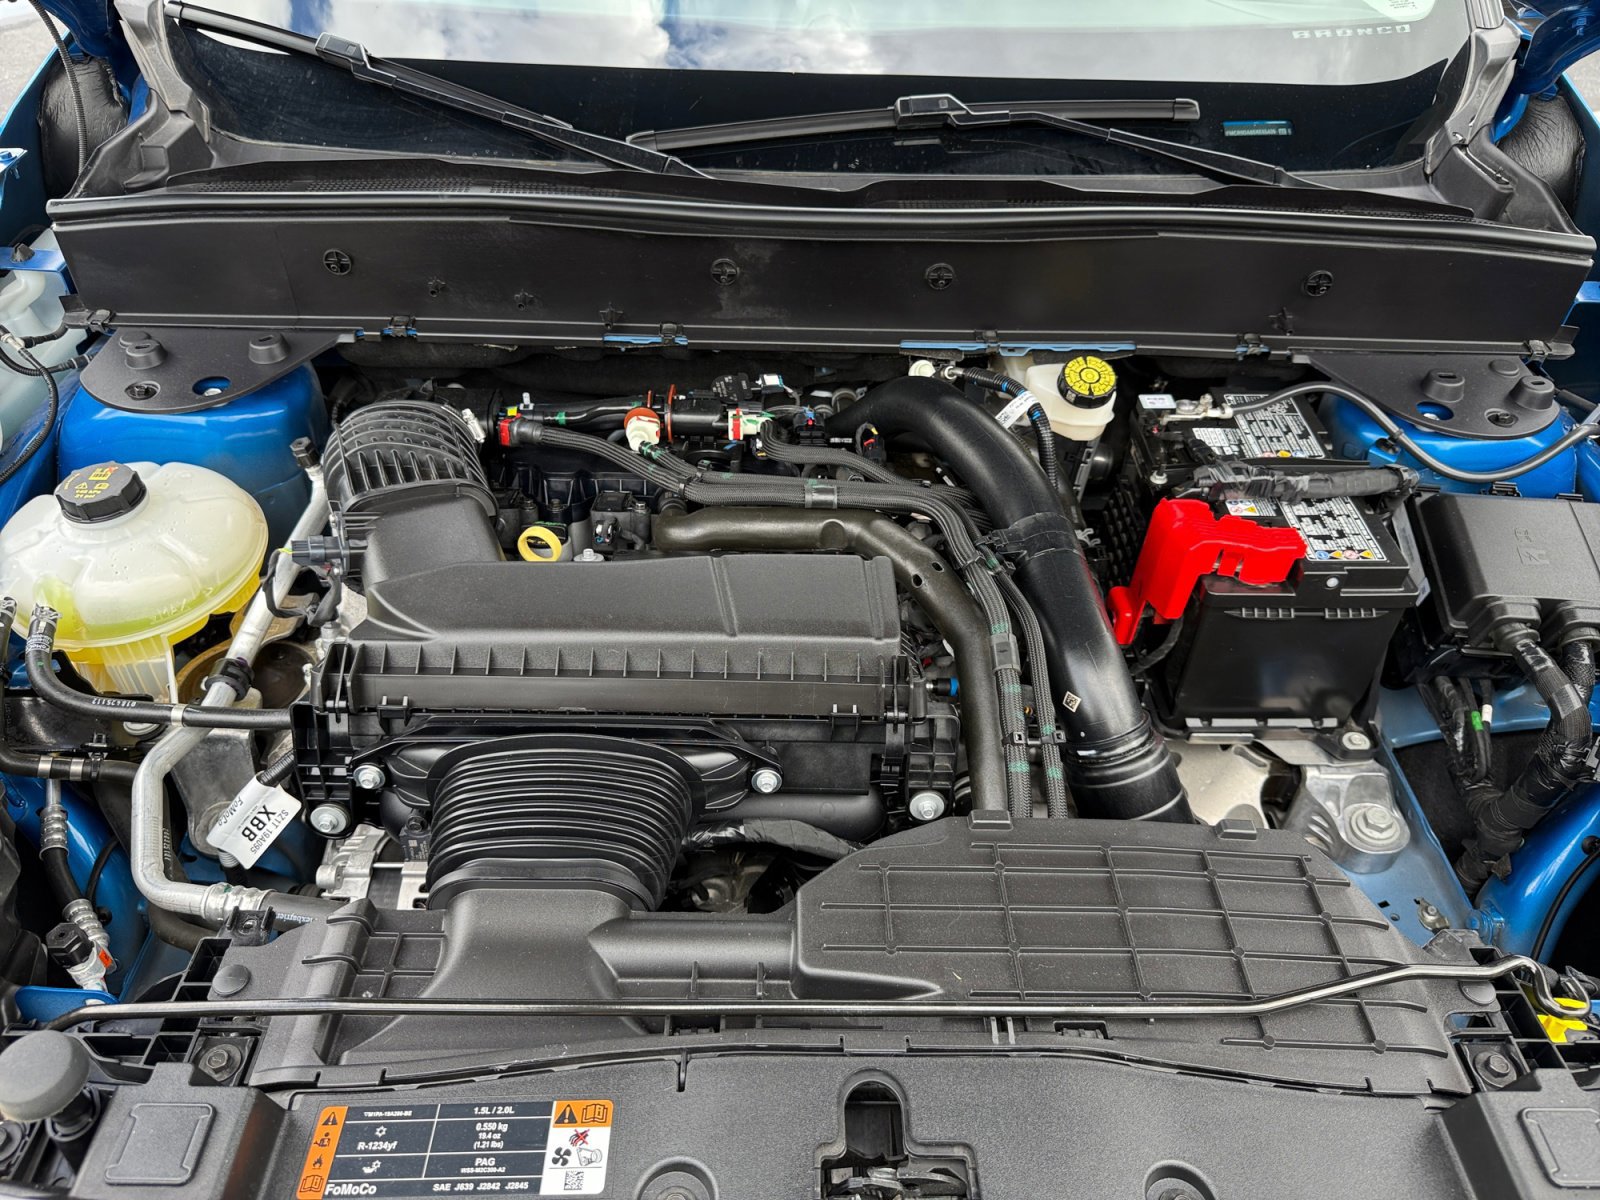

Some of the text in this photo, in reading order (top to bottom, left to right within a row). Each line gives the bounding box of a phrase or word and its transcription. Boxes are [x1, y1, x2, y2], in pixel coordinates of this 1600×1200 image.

[1292, 24, 1411, 39] BRONCO
[218, 796, 243, 826] FoMoCo
[241, 804, 276, 842] XBB
[250, 829, 273, 854] 19A095
[276, 913, 313, 923] lexbarrier
[473, 1106, 491, 1115] 1.5L
[496, 1106, 515, 1114] 2.0L
[475, 1122, 508, 1132] 0.550 kg
[356, 1141, 398, 1152] R-1234yf
[473, 1140, 504, 1150] (1.21 lbs)
[474, 1157, 496, 1166] PAG
[324, 1183, 377, 1196] FoMoCo
[432, 1181, 529, 1191] SAE J639 J2842 J2845
